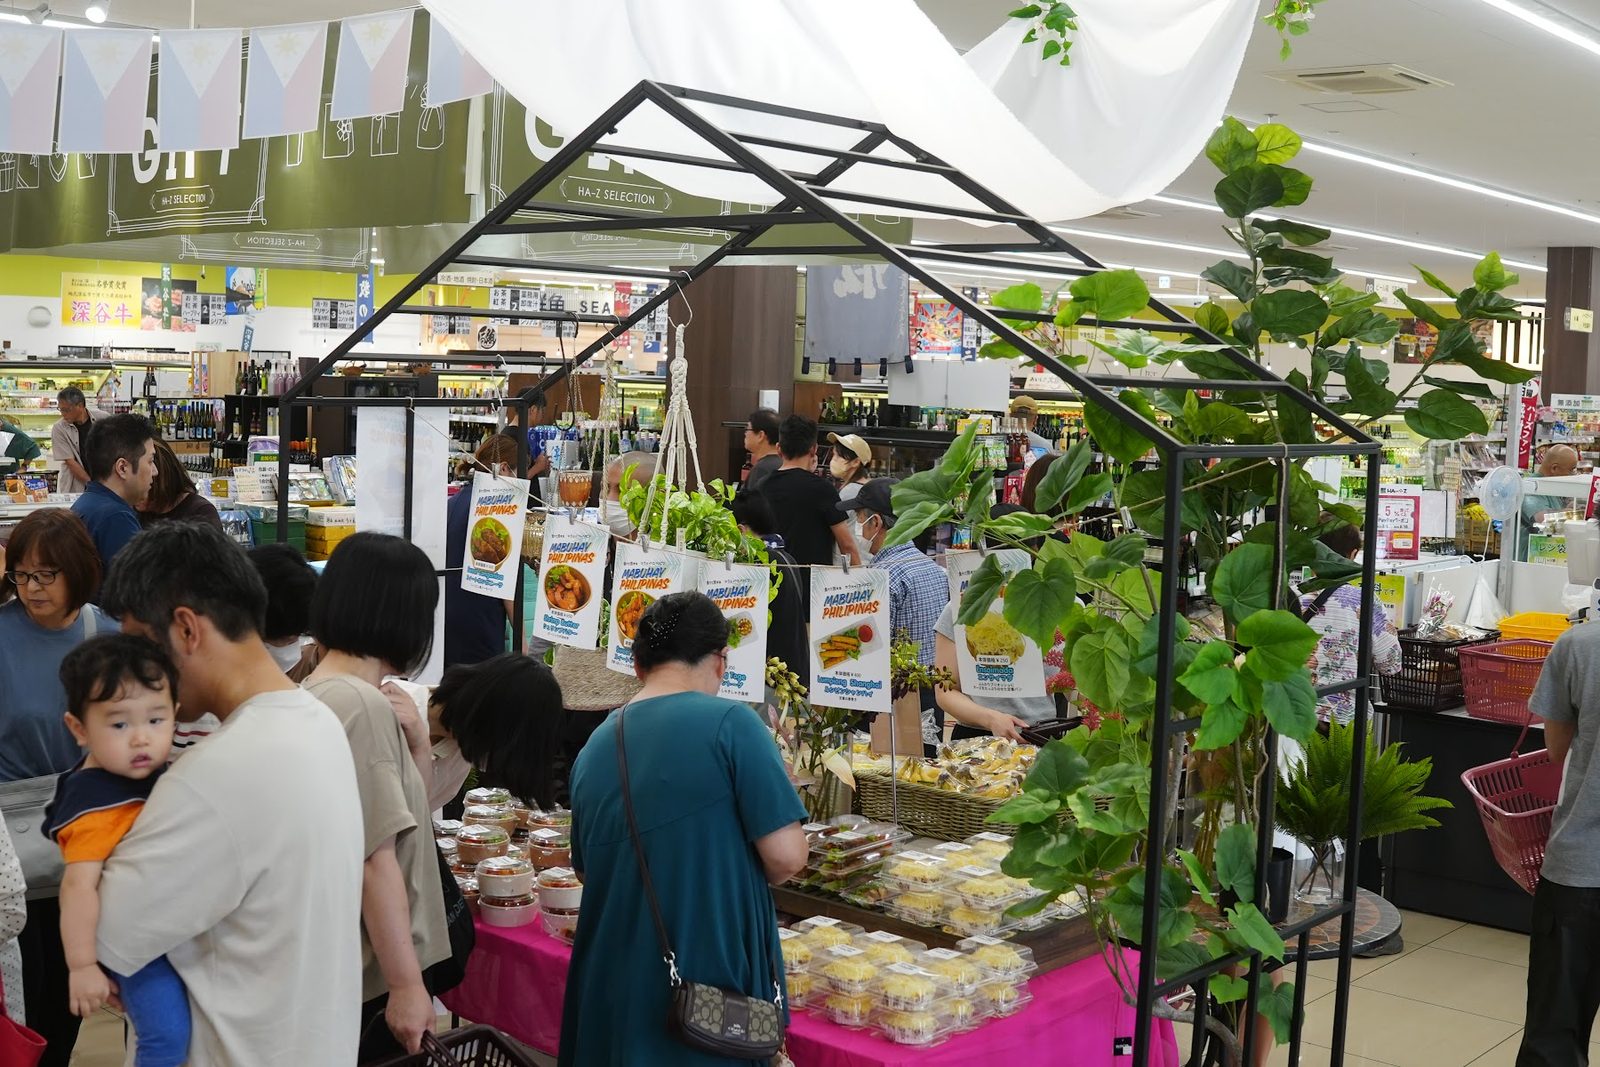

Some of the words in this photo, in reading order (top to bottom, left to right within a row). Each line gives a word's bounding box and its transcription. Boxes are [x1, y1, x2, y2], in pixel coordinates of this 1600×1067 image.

[173, 194, 207, 205] SELECTION
[578, 187, 601, 199] HA-Z
[604, 189, 655, 205] SELECTION
[70, 300, 134, 324] 深谷牛
[203, 305, 208, 314] 2
[580, 300, 611, 314] SEA
[331, 310, 337, 319] 3
[477, 494, 515, 506] MABUHAY
[474, 504, 518, 517] PHILIPINAS
[1385, 505, 1391, 517] 5
[549, 541, 593, 553] MABUHAY
[547, 552, 595, 564] PHILIPINAS
[621, 566, 667, 579] MABUHAY
[619, 577, 671, 591] PHILIPINAS
[706, 585, 752, 598] MABUHAY
[823, 588, 874, 608] MABUHAY
[821, 600, 880, 620] PHILIPINAS
[850, 678, 883, 690] Shanghai
